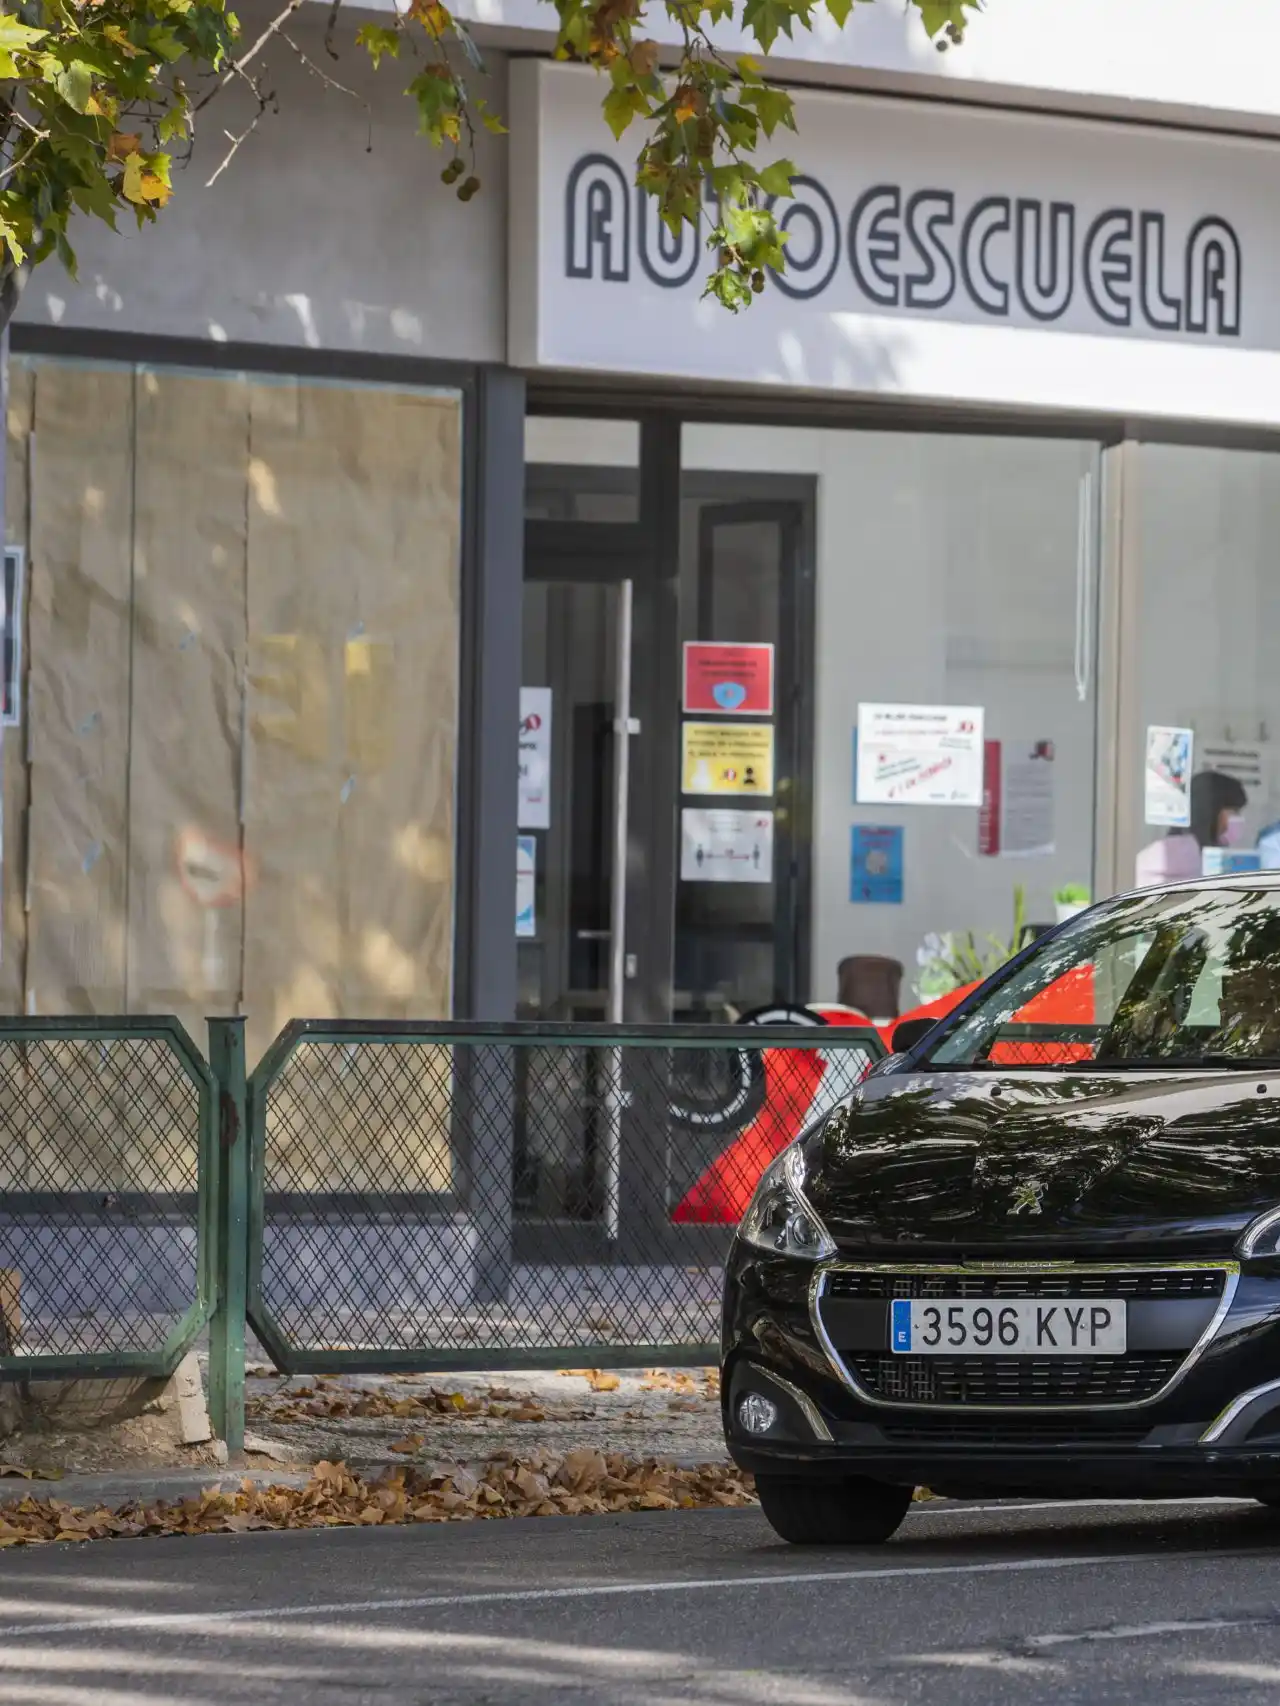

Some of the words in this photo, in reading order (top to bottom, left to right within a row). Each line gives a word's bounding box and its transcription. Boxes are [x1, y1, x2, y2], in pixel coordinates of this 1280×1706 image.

[566, 153, 1242, 336] AUOESCUELA
[898, 1331, 906, 1342] E
[922, 1307, 1019, 1346] 3596
[1036, 1307, 1112, 1346] KYP
